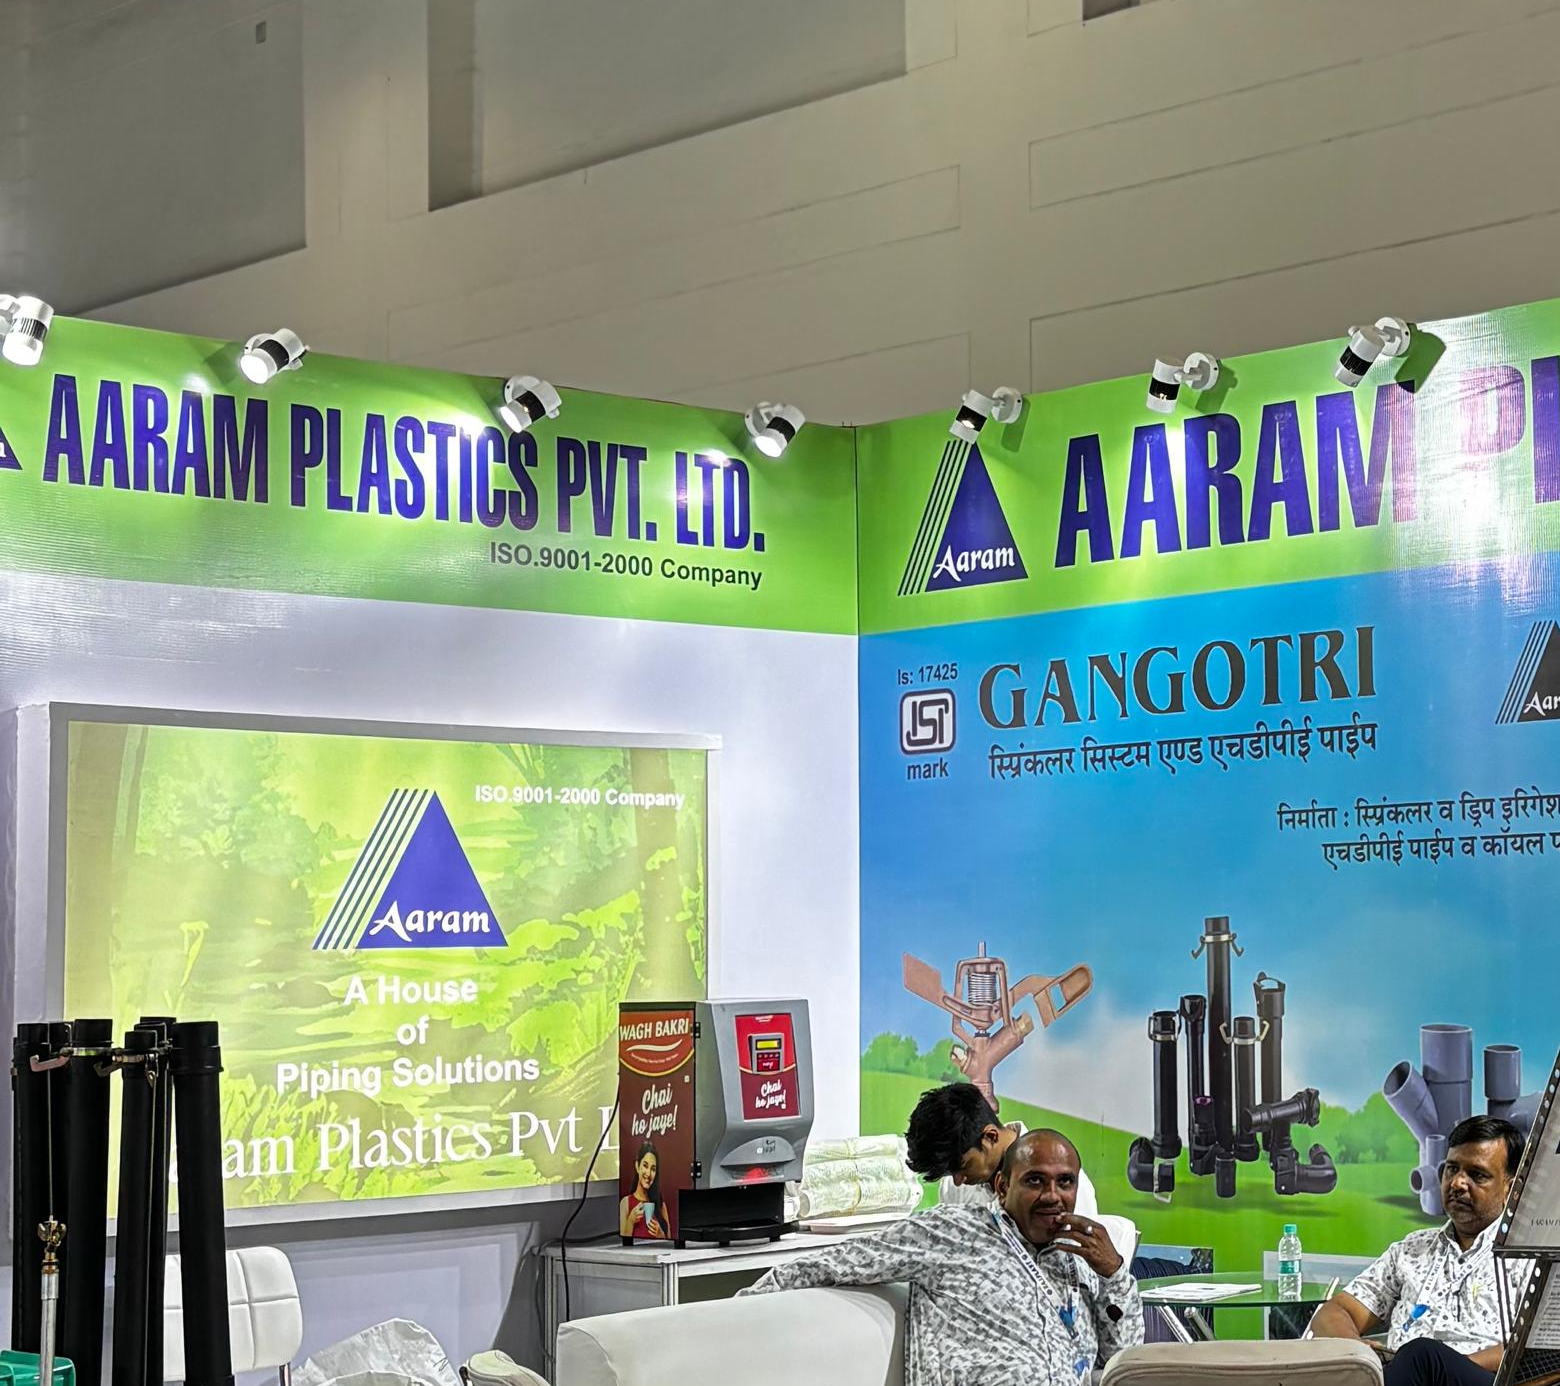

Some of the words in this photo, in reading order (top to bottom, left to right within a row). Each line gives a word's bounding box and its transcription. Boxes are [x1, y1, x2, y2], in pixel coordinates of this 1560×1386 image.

[42, 372, 269, 505] AARAM
[290, 400, 539, 533] PLASTICS
[555, 435, 659, 542] PVT.
[674, 449, 767, 553] LTD.
[1054, 380, 1418, 569] AARAM
[490, 539, 654, 577] ISO.9001-2000
[659, 555, 763, 592] Company
[931, 537, 1016, 581] Aaram
[918, 662, 959, 685] 17425
[978, 625, 1379, 731] GANGOTRI
[988, 738, 1076, 781] स्प्रिंकलर
[1081, 734, 1152, 775] सिस्टम
[1156, 733, 1205, 777] एण्ड
[1208, 713, 1314, 773] एचडीपीई
[1317, 711, 1380, 762] पाईप
[906, 758, 949, 781] mark
[475, 784, 600, 805] ISO.9001-2000
[605, 789, 686, 811] Company
[1276, 799, 1338, 831] निर्माता
[1355, 795, 1434, 829] स्प्रिंकलर
[1437, 799, 1457, 822] व
[1459, 791, 1497, 829] ड्रिप
[1322, 832, 1404, 871] एचडीपीई
[1407, 828, 1455, 866] पाईप
[1459, 836, 1477, 858] व
[1480, 826, 1546, 857] कॉयल
[369, 899, 491, 943] Aaram
[343, 976, 369, 1006] A
[377, 974, 479, 1005] House
[396, 1015, 429, 1046] of
[620, 1022, 652, 1041] WAGH
[655, 1018, 689, 1037] BAKRI
[276, 1061, 383, 1099] Piping
[392, 1056, 541, 1088] Solutions
[760, 1080, 782, 1097] Chai
[641, 1083, 673, 1115] Chai
[314, 1116, 493, 1171] Plastics
[508, 1105, 585, 1158] Pvt
[632, 1112, 646, 1136] ho
[645, 1105, 678, 1139] jaye!
